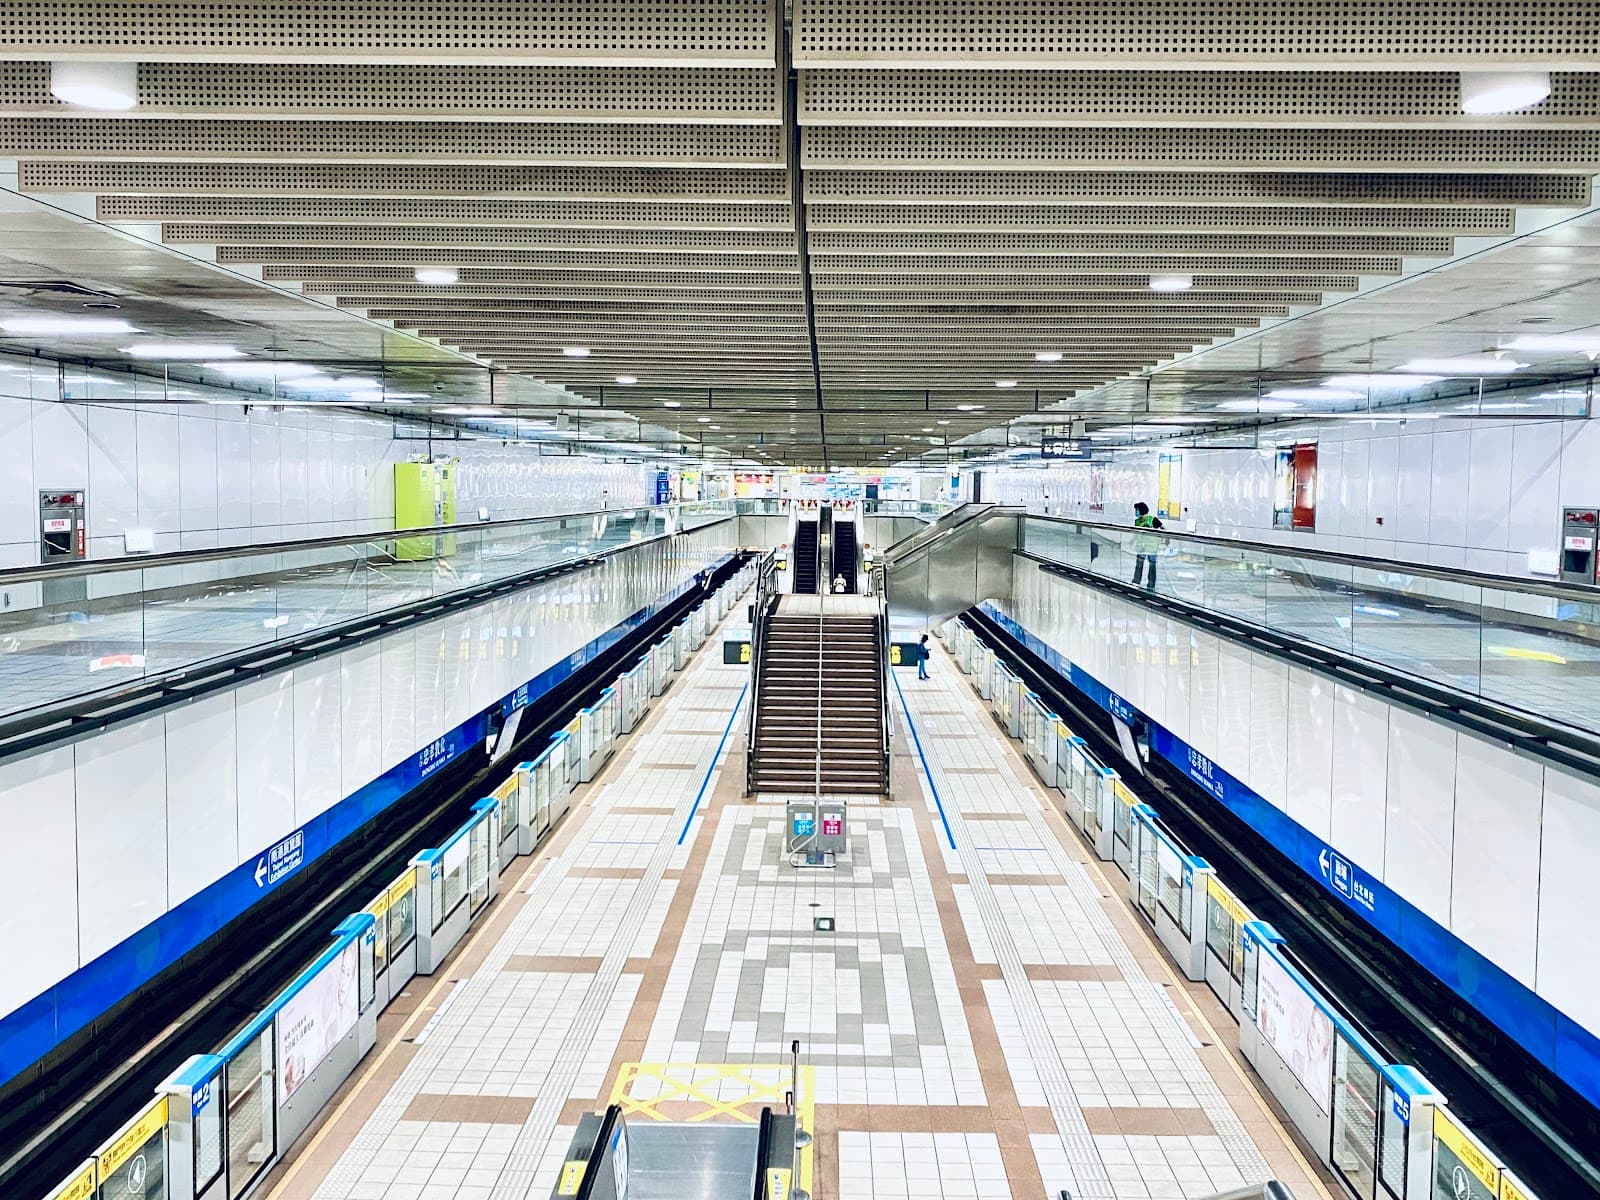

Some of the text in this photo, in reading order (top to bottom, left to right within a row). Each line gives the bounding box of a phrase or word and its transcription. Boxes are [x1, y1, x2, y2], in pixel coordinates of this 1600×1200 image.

[423, 737, 446, 765] 忠孝敦化
[1191, 750, 1213, 780] 忠孝敦化
[270, 833, 302, 865] 南港展覽館
[202, 1082, 210, 1103] 2
[1402, 1101, 1409, 1121] 5
